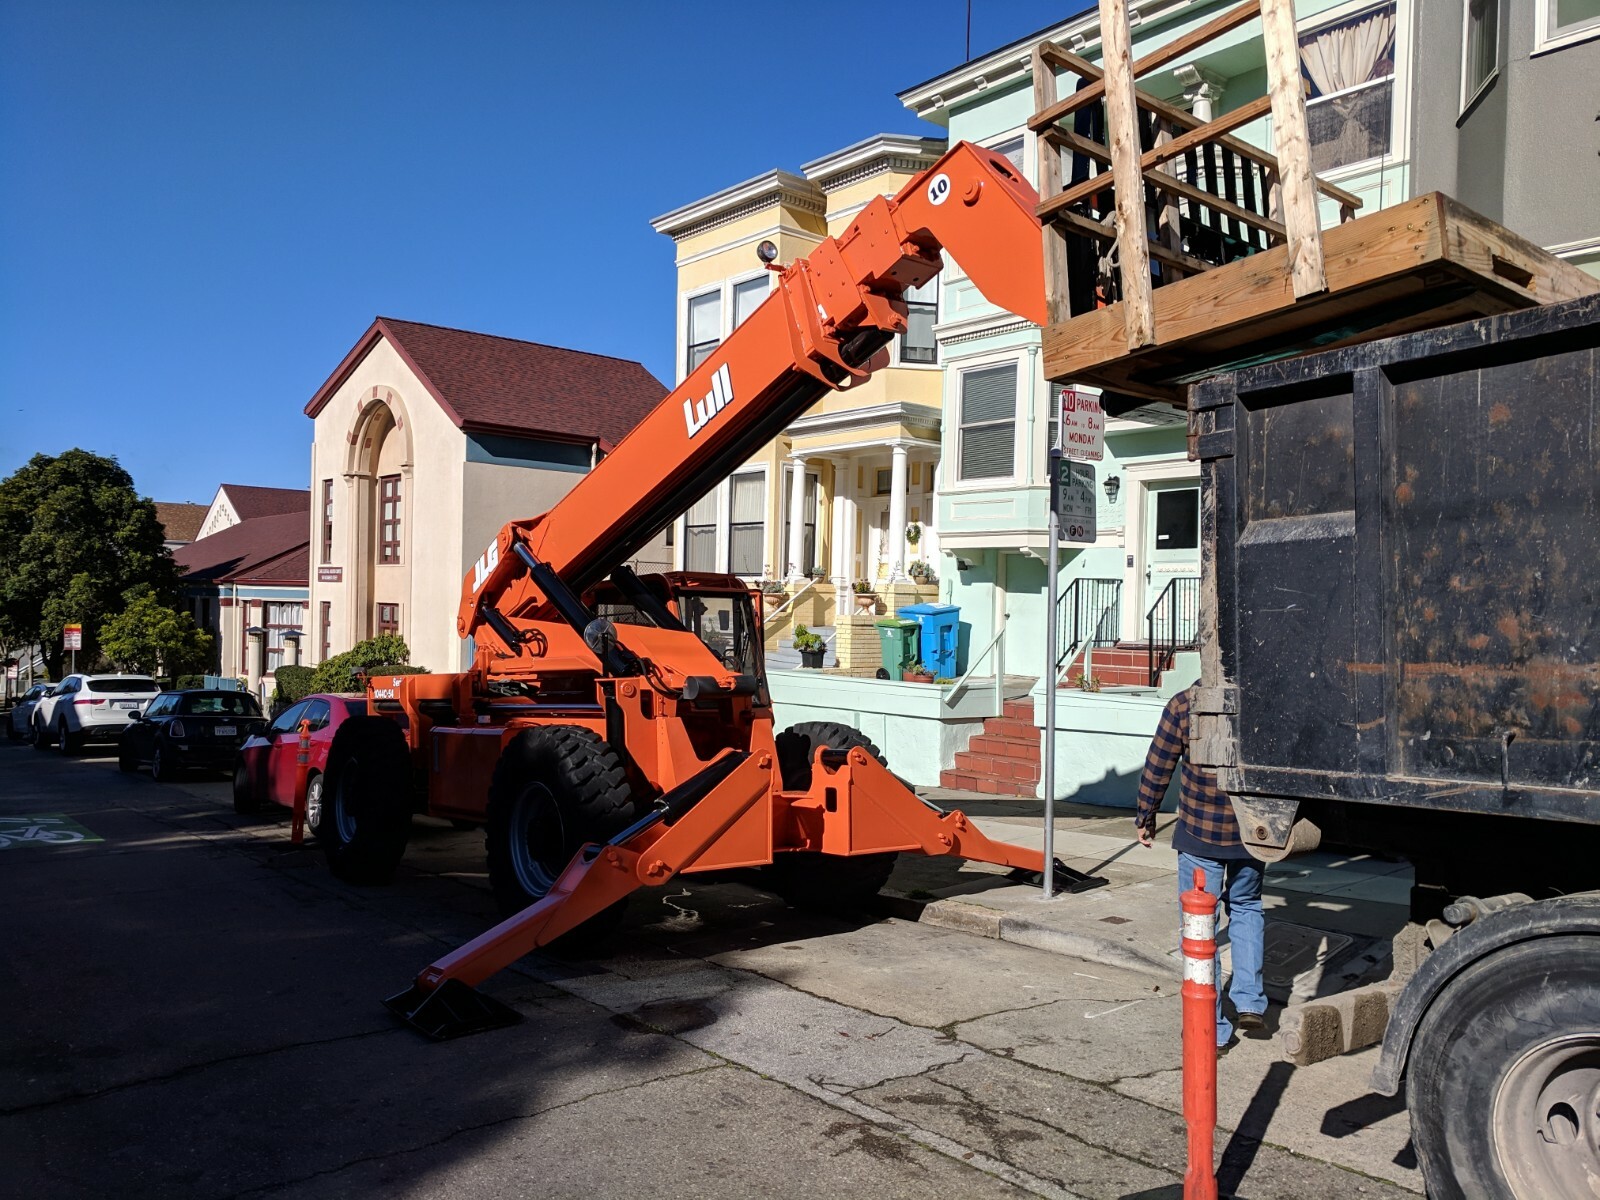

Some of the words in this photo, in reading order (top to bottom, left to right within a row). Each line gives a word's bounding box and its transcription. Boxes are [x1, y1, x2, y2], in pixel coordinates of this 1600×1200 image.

[930, 179, 947, 201] 10
[683, 362, 734, 439] Lull
[1069, 432, 1095, 445] MONDAY
[1063, 447, 1079, 456] STREET
[1081, 449, 1101, 459] CLEANING
[1061, 465, 1068, 482] 2
[1072, 477, 1093, 490] PARKING
[1063, 503, 1073, 513] MON
[473, 538, 499, 593] JLG
